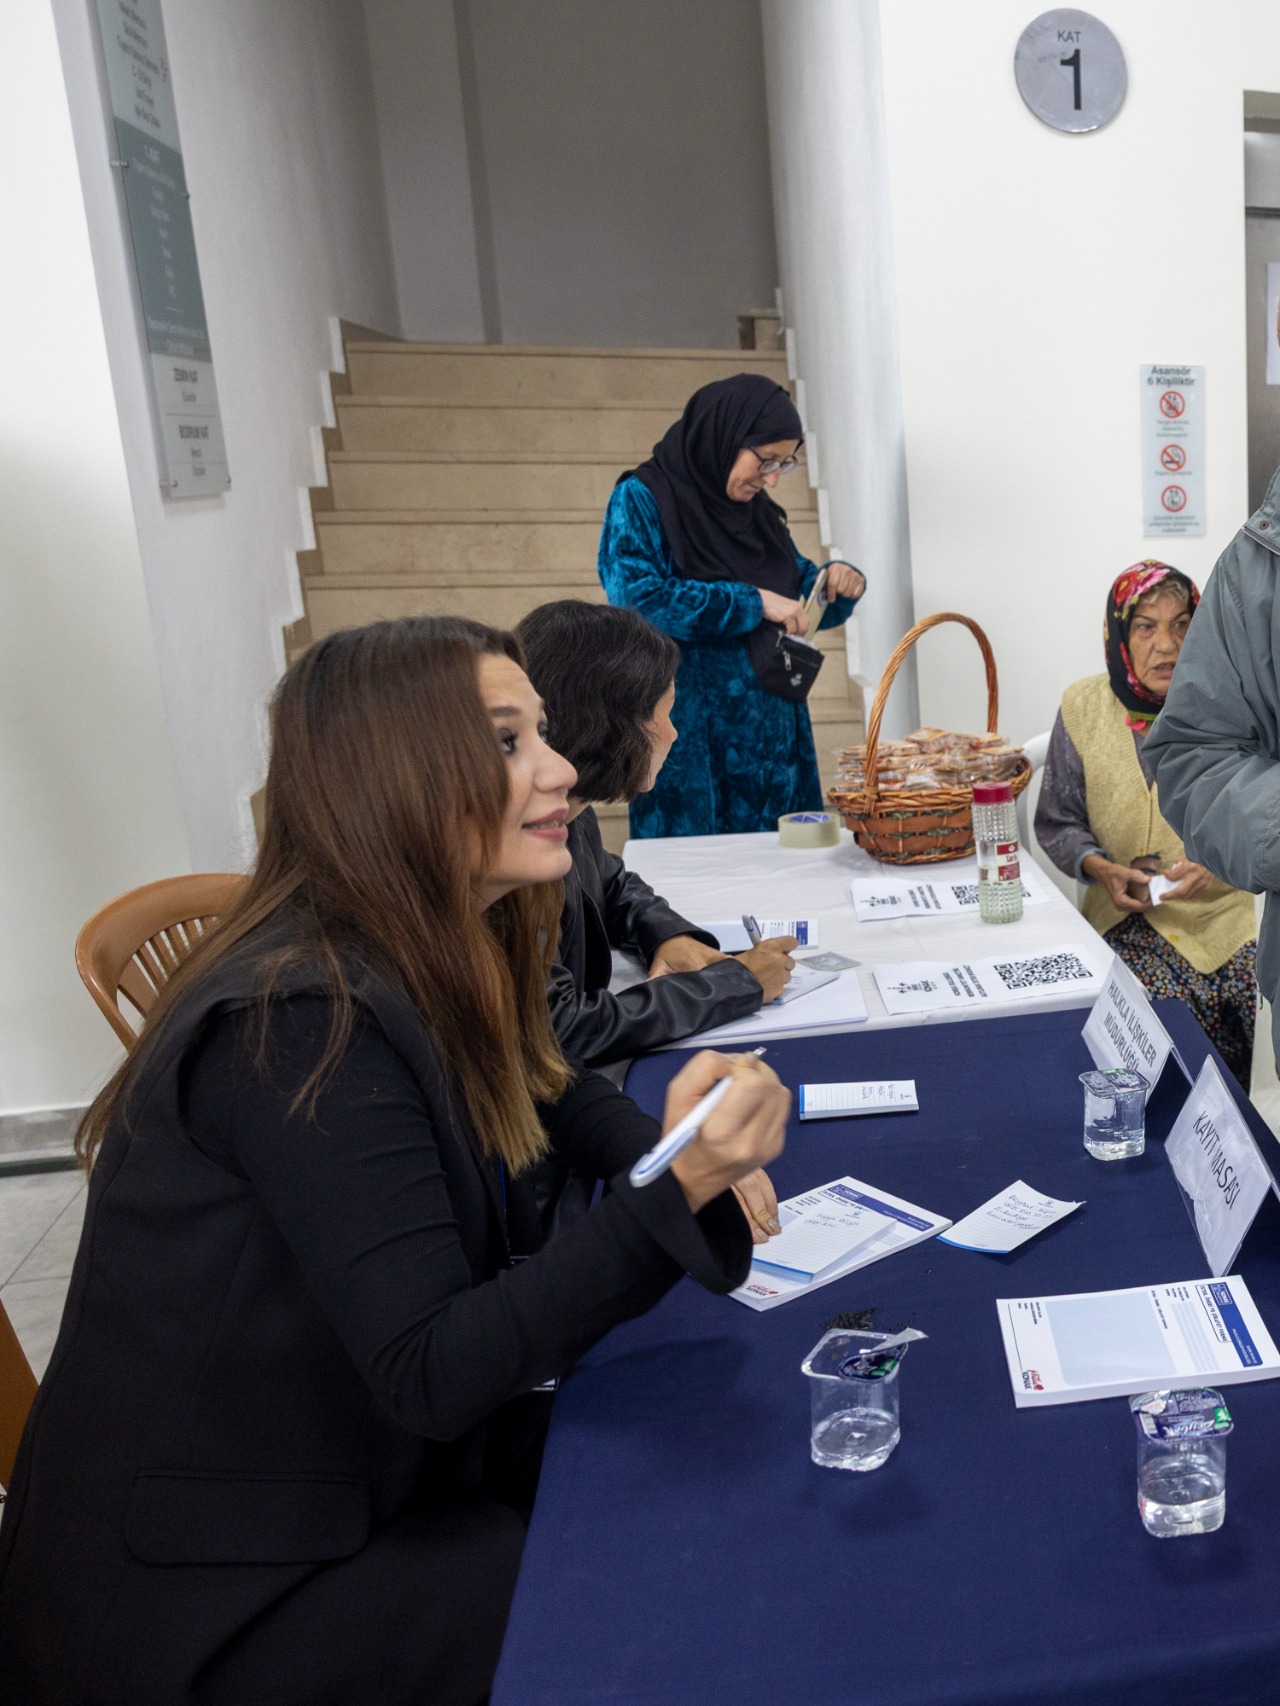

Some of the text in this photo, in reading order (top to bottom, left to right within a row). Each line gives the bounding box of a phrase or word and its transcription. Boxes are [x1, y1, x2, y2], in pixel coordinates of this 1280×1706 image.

[1057, 30, 1081, 43] KAT
[1060, 49, 1081, 110] 1
[1147, 376, 1195, 387] 6 Kişiliktir
[1151, 365, 1191, 375] Asansör
[1103, 1011, 1140, 1071] MÜDÜRLÜĞÜ
[1107, 979, 1157, 1068] HALKLA İLİŞKİLER
[1193, 1110, 1241, 1210] KAYIT MASASI
[1021, 1371, 1032, 1389] KONAK
